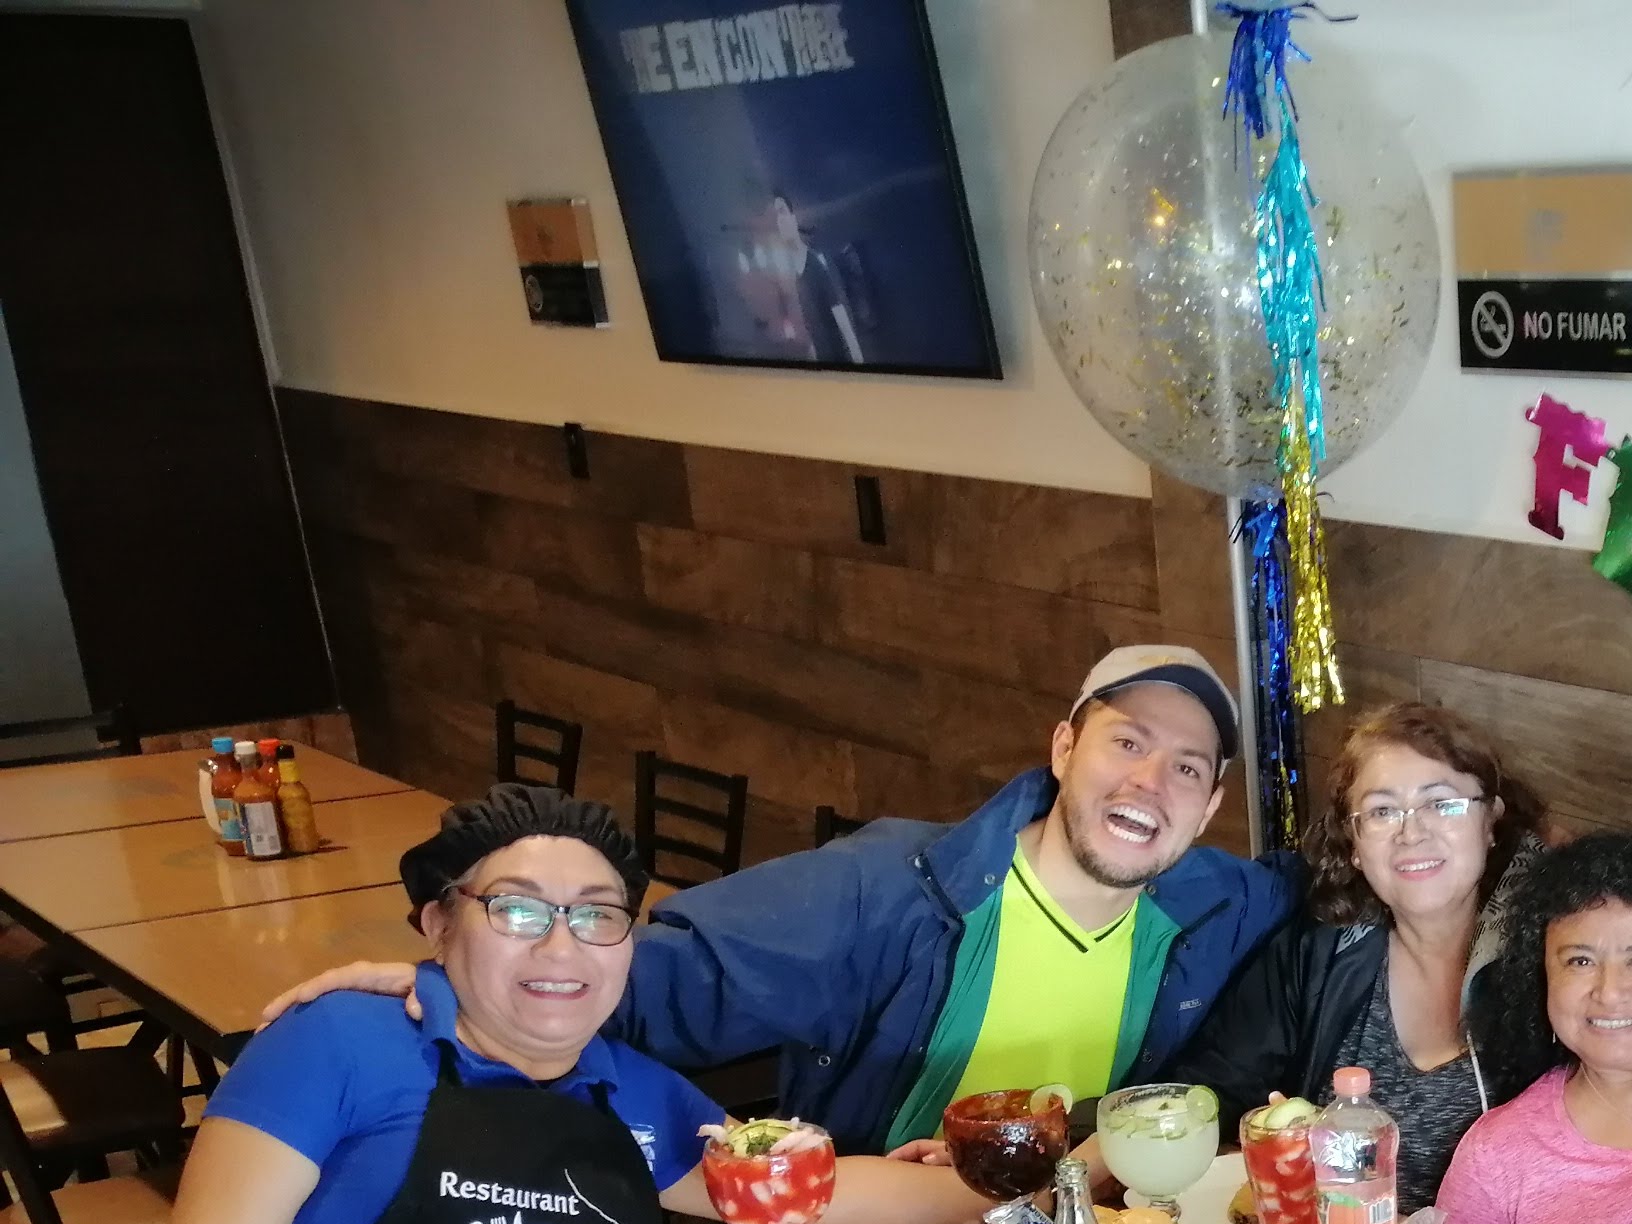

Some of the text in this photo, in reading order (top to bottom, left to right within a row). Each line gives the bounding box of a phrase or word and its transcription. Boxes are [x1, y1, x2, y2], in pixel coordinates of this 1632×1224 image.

[1524, 311, 1627, 341] NO FUMAR
[440, 1171, 580, 1216] Restaurant
